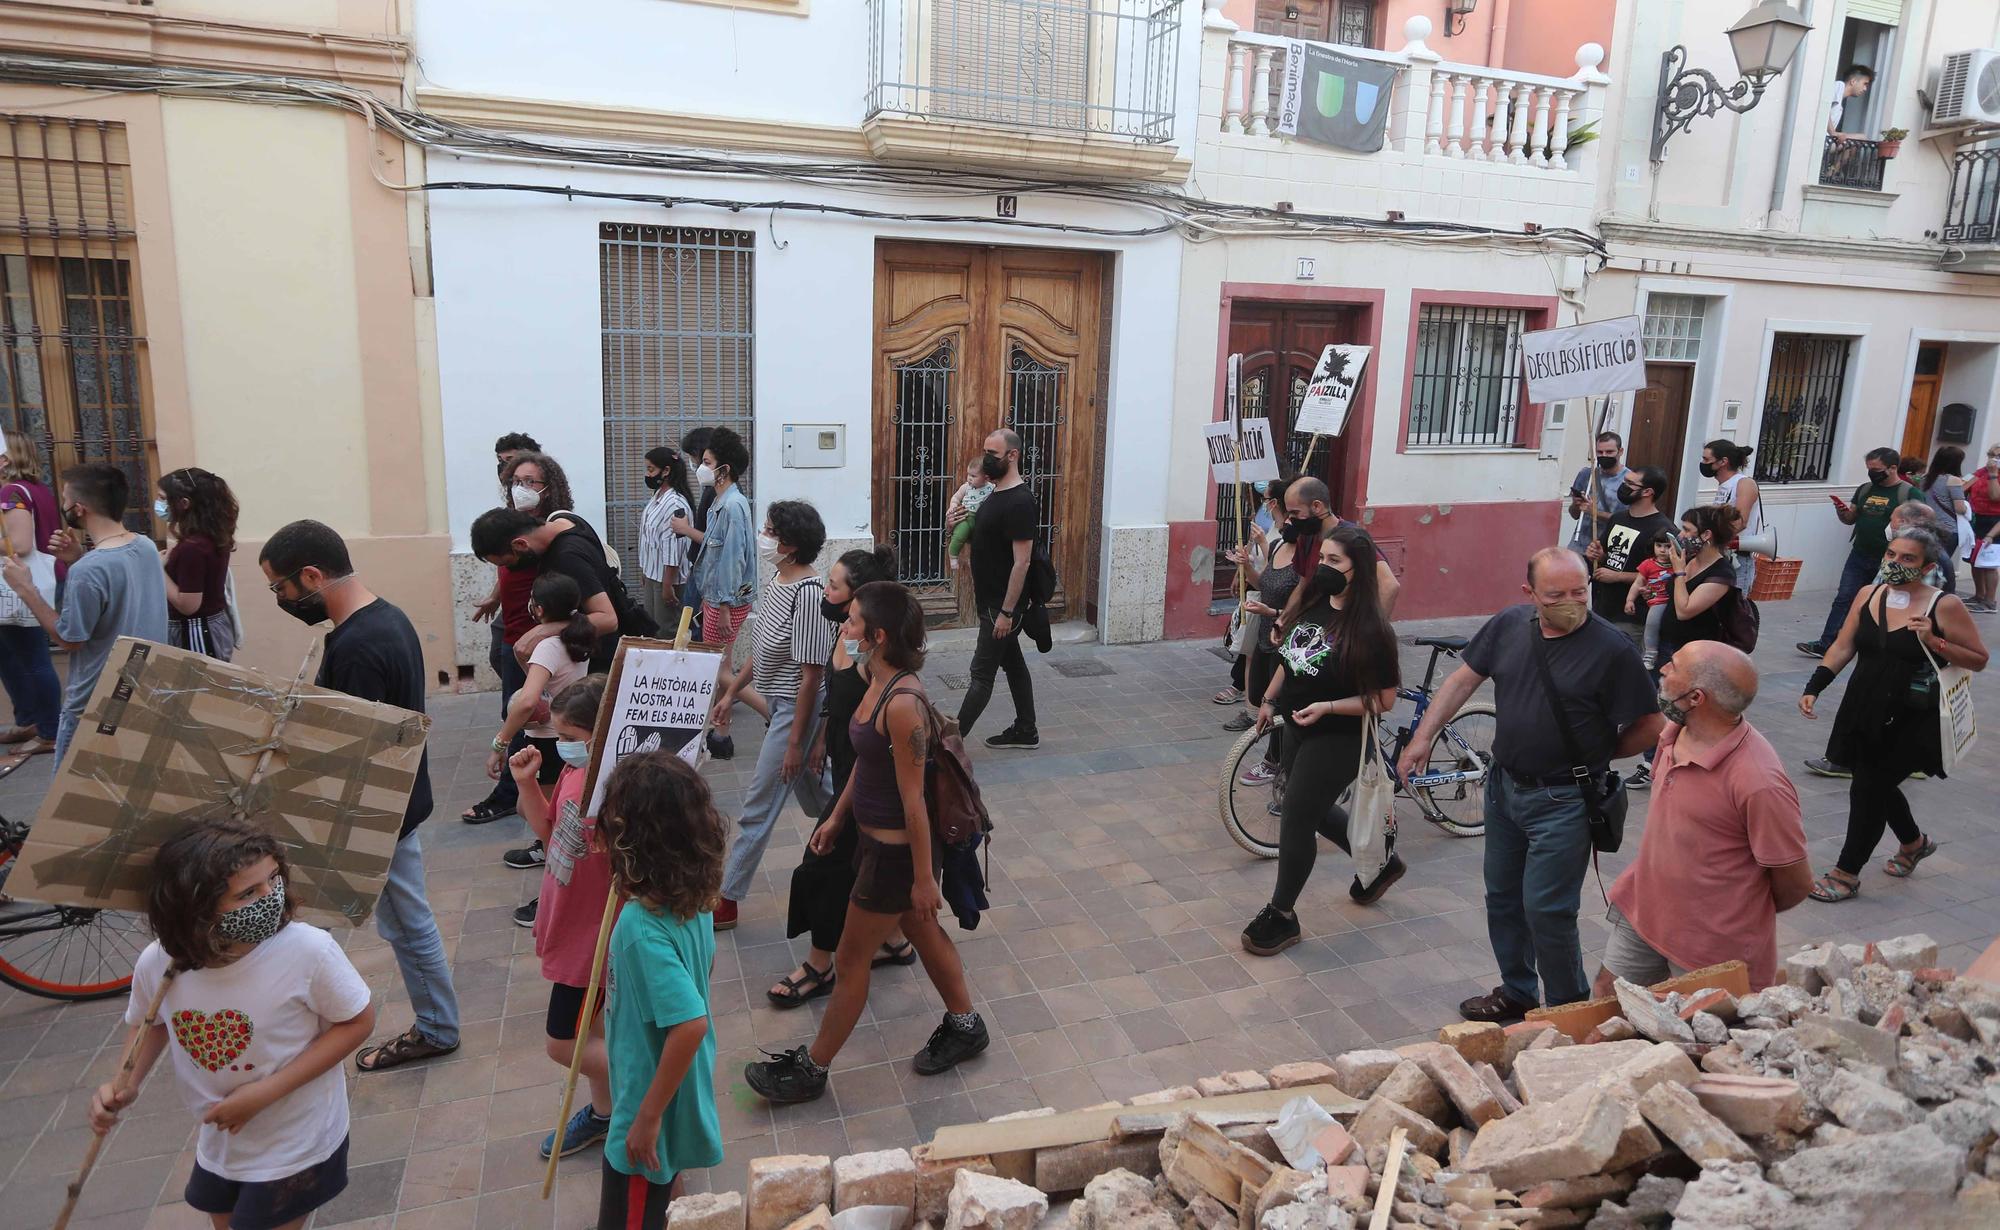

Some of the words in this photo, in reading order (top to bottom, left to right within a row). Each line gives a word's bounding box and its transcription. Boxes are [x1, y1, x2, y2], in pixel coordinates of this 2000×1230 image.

[1281, 43, 1303, 129] Benimaclet
[998, 197, 1015, 215] 14
[1299, 260, 1315, 277] 12
[1527, 332, 1637, 380] DESCLASSIFICACIÓ
[1308, 384, 1347, 401] PAIZILLA
[634, 675, 648, 689] LA
[652, 676, 697, 694] HISTÒRIA
[700, 680, 712, 695] ÉS
[630, 692, 673, 707] NOSTRA
[676, 696, 681, 707] I
[682, 697, 695, 709] LA
[625, 709, 648, 722] FEM
[651, 711, 667, 723] ELS
[670, 712, 705, 726] BARRIS
[1414, 775, 1455, 786] SCOTT
